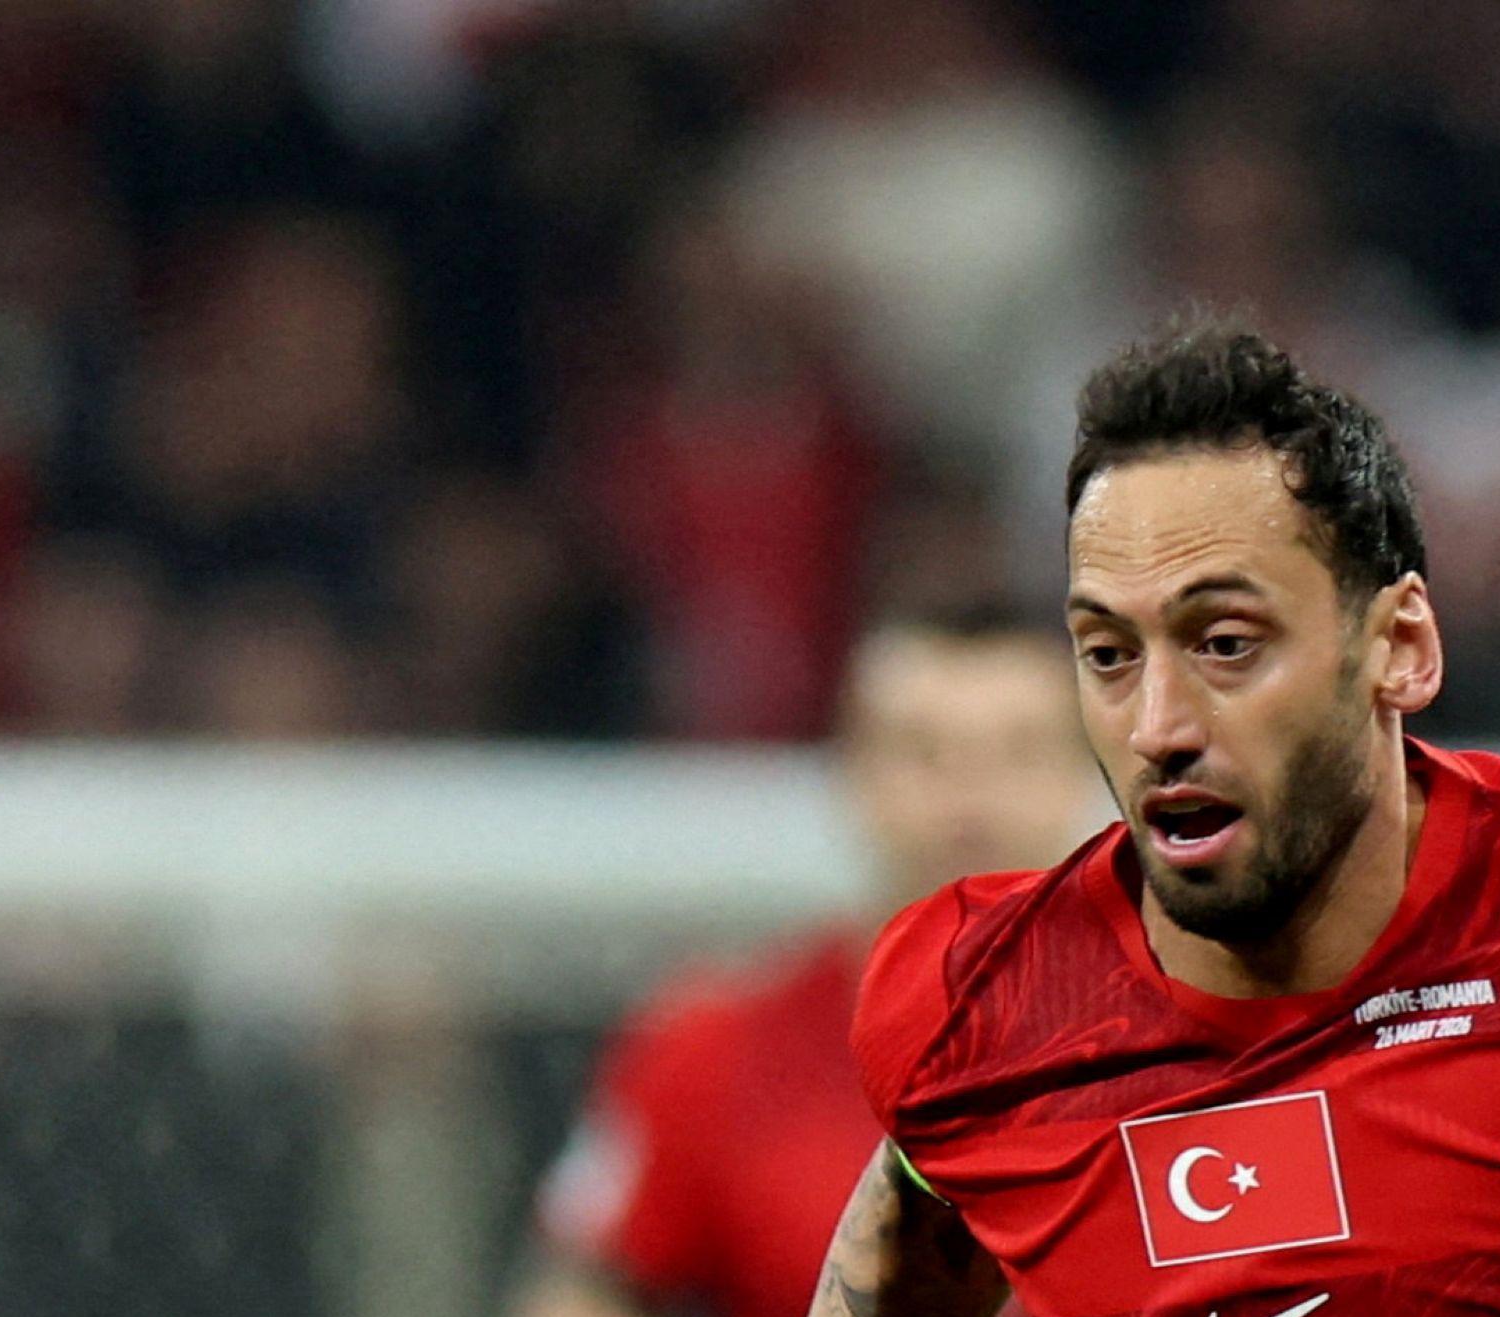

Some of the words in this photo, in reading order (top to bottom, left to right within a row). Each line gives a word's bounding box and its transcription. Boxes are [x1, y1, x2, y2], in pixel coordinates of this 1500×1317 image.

[1373, 1025, 1393, 1050] 26
[1393, 1019, 1437, 1045] MART
[1434, 1014, 1474, 1038] 2026
